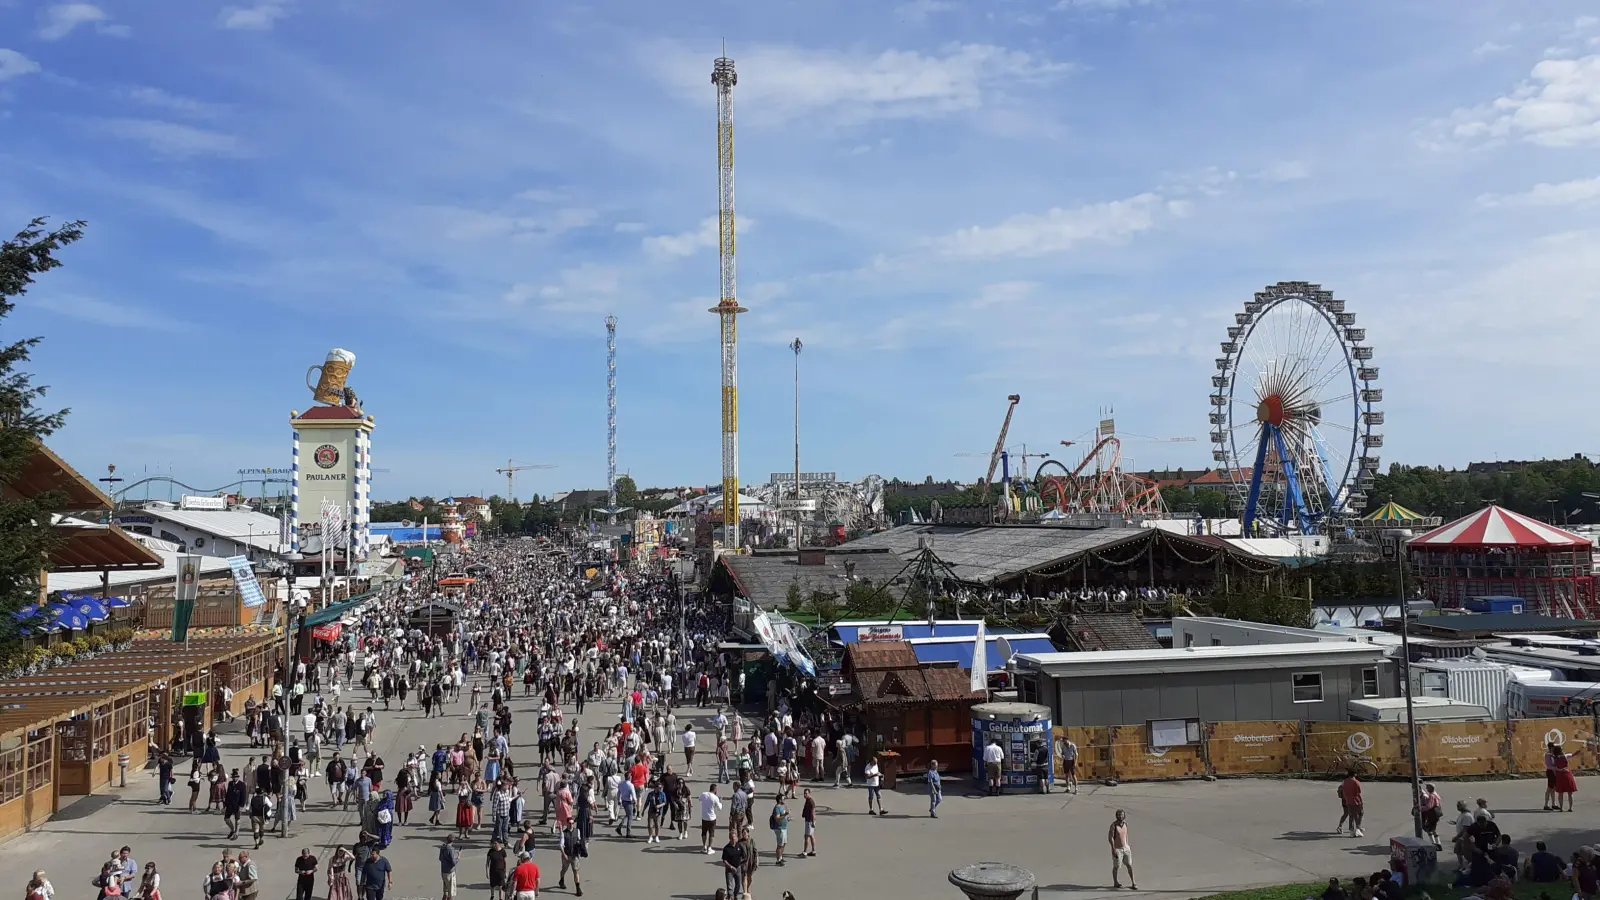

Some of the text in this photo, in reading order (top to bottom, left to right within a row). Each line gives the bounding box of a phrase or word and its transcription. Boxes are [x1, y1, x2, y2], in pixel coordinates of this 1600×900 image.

[306, 473, 347, 481] PAULANER
[988, 722, 1044, 732] Geldautomat
[1441, 735, 1480, 744] Oktoberfest
